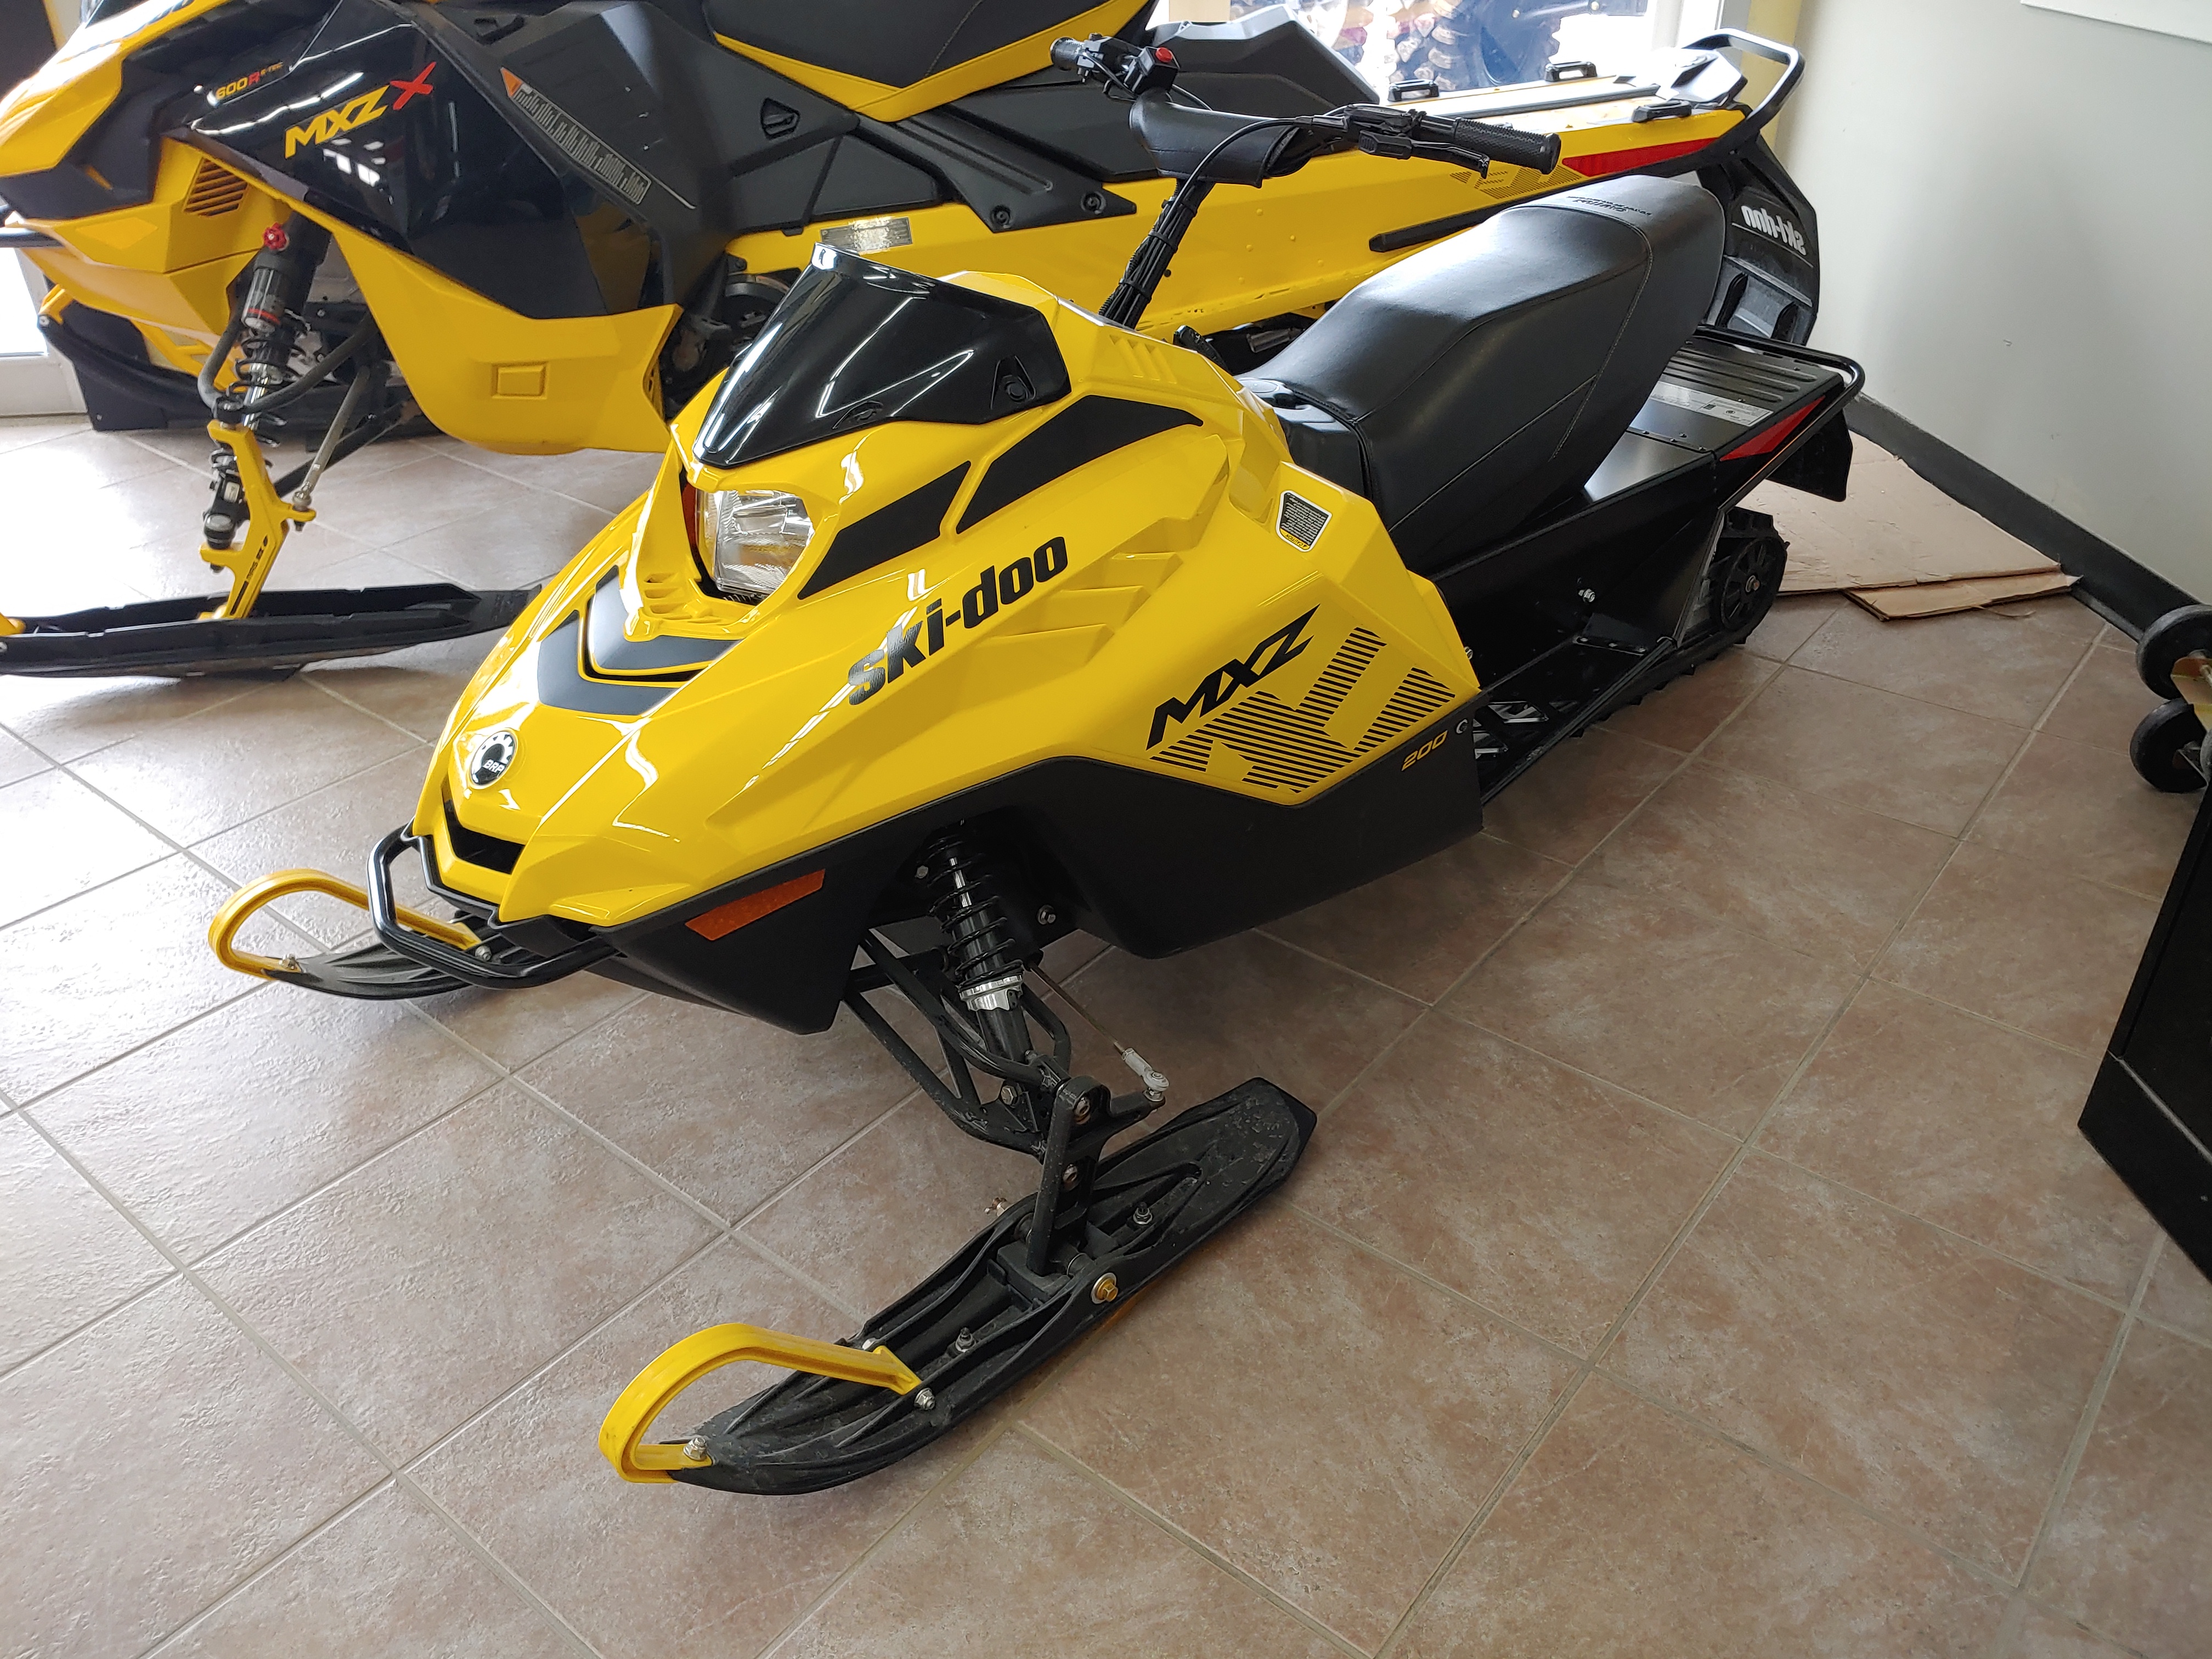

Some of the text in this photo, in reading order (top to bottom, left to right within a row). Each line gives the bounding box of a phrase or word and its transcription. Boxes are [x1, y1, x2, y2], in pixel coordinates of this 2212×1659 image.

[285, 61, 437, 159] MXZ X
[1146, 603, 1321, 751] MXZ
[482, 759, 506, 774] BRP
[1401, 729, 1448, 772] 200
